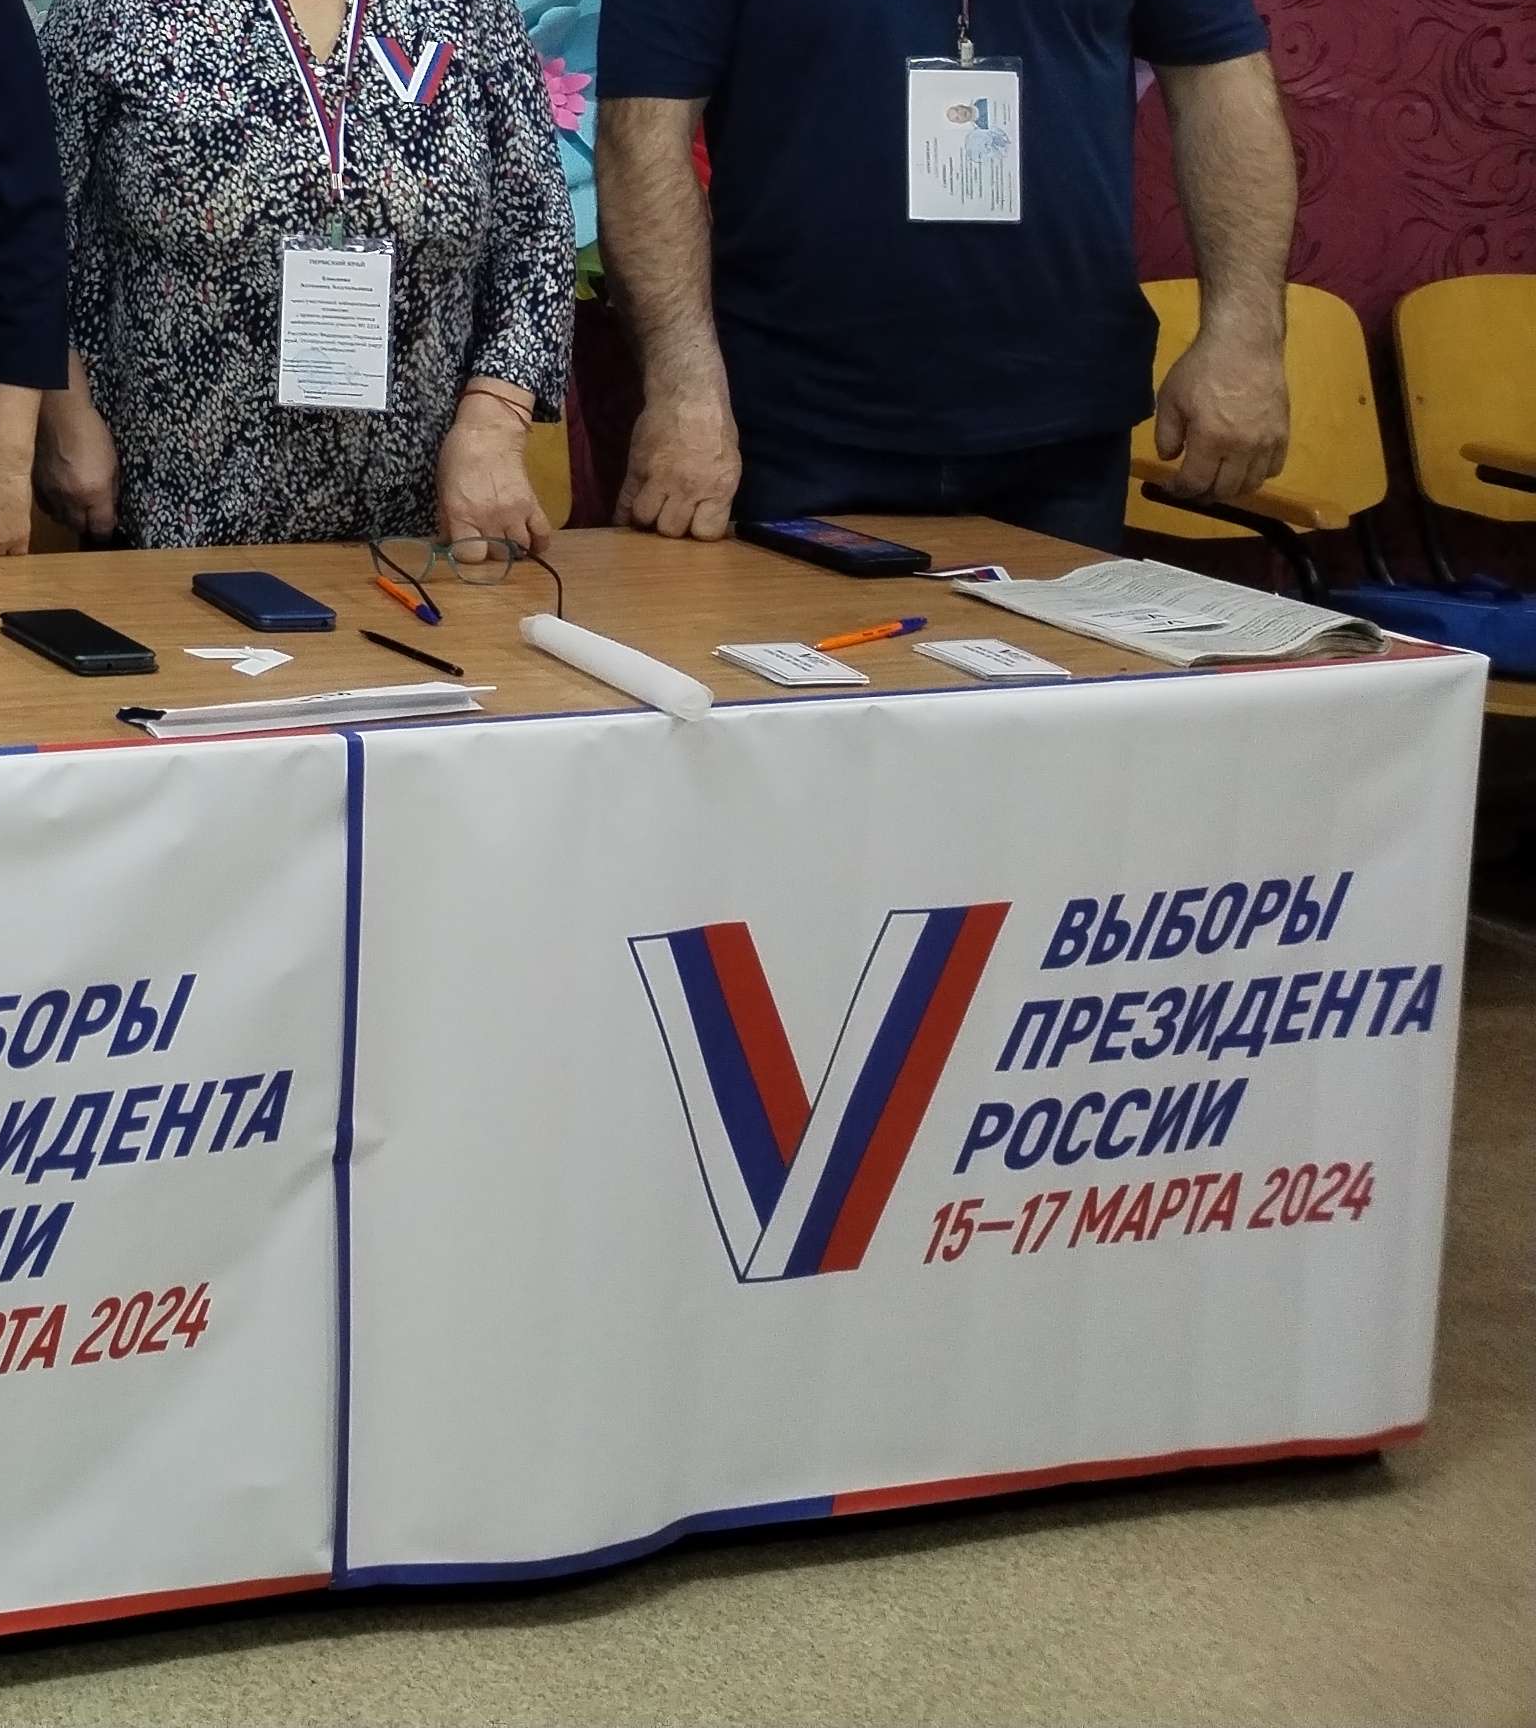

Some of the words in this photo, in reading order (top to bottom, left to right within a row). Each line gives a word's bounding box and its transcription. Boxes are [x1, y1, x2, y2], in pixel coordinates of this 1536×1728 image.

[1041, 872, 1352, 969] ВЫБОРЫ
[997, 964, 1442, 1071] ПРЕЗИДЕНТА
[954, 1077, 1247, 1173] РОССИИ
[1068, 1173, 1239, 1248] МАРТА
[1248, 1161, 1373, 1229] 2024
[73, 1282, 210, 1363] 2024
